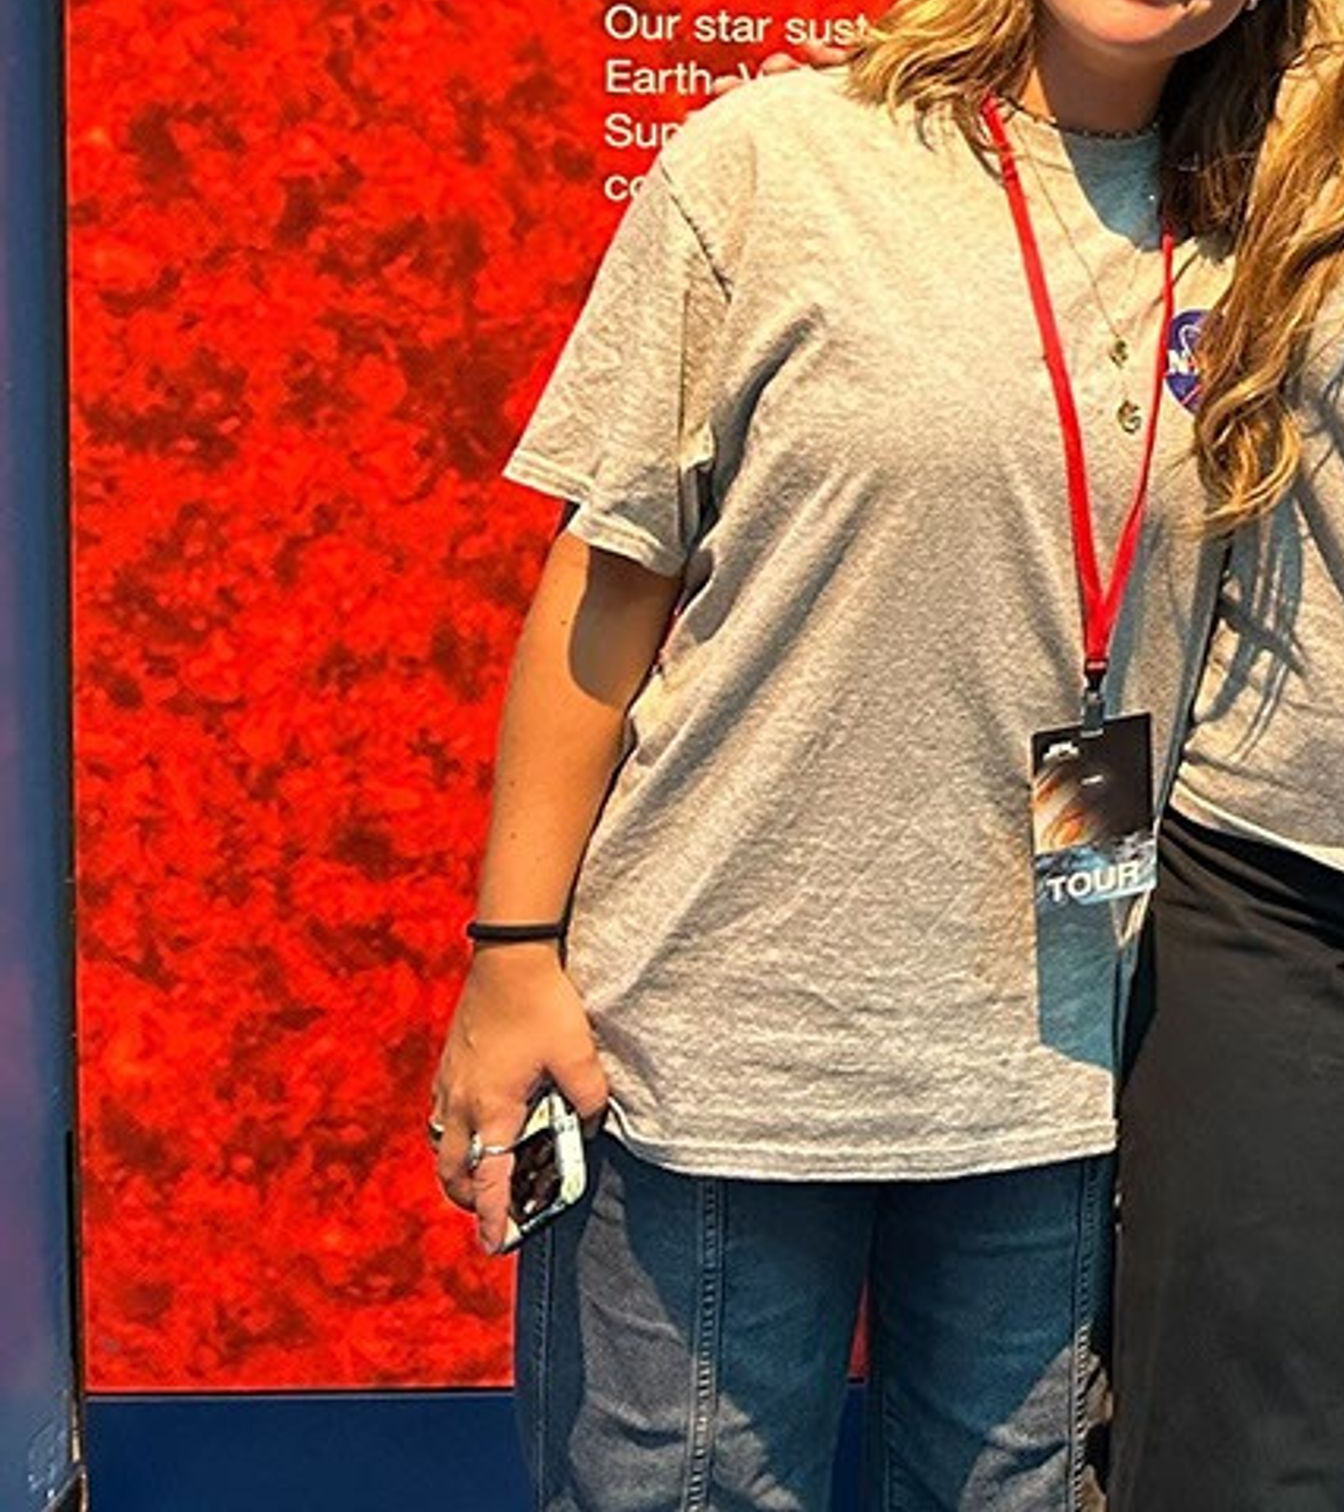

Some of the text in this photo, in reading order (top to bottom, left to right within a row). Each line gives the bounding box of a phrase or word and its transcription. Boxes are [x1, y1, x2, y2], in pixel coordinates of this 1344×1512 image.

[605, 3, 681, 40] Our
[694, 10, 772, 43] star
[606, 59, 712, 96] Earth
[1046, 860, 1139, 903] TOUR
